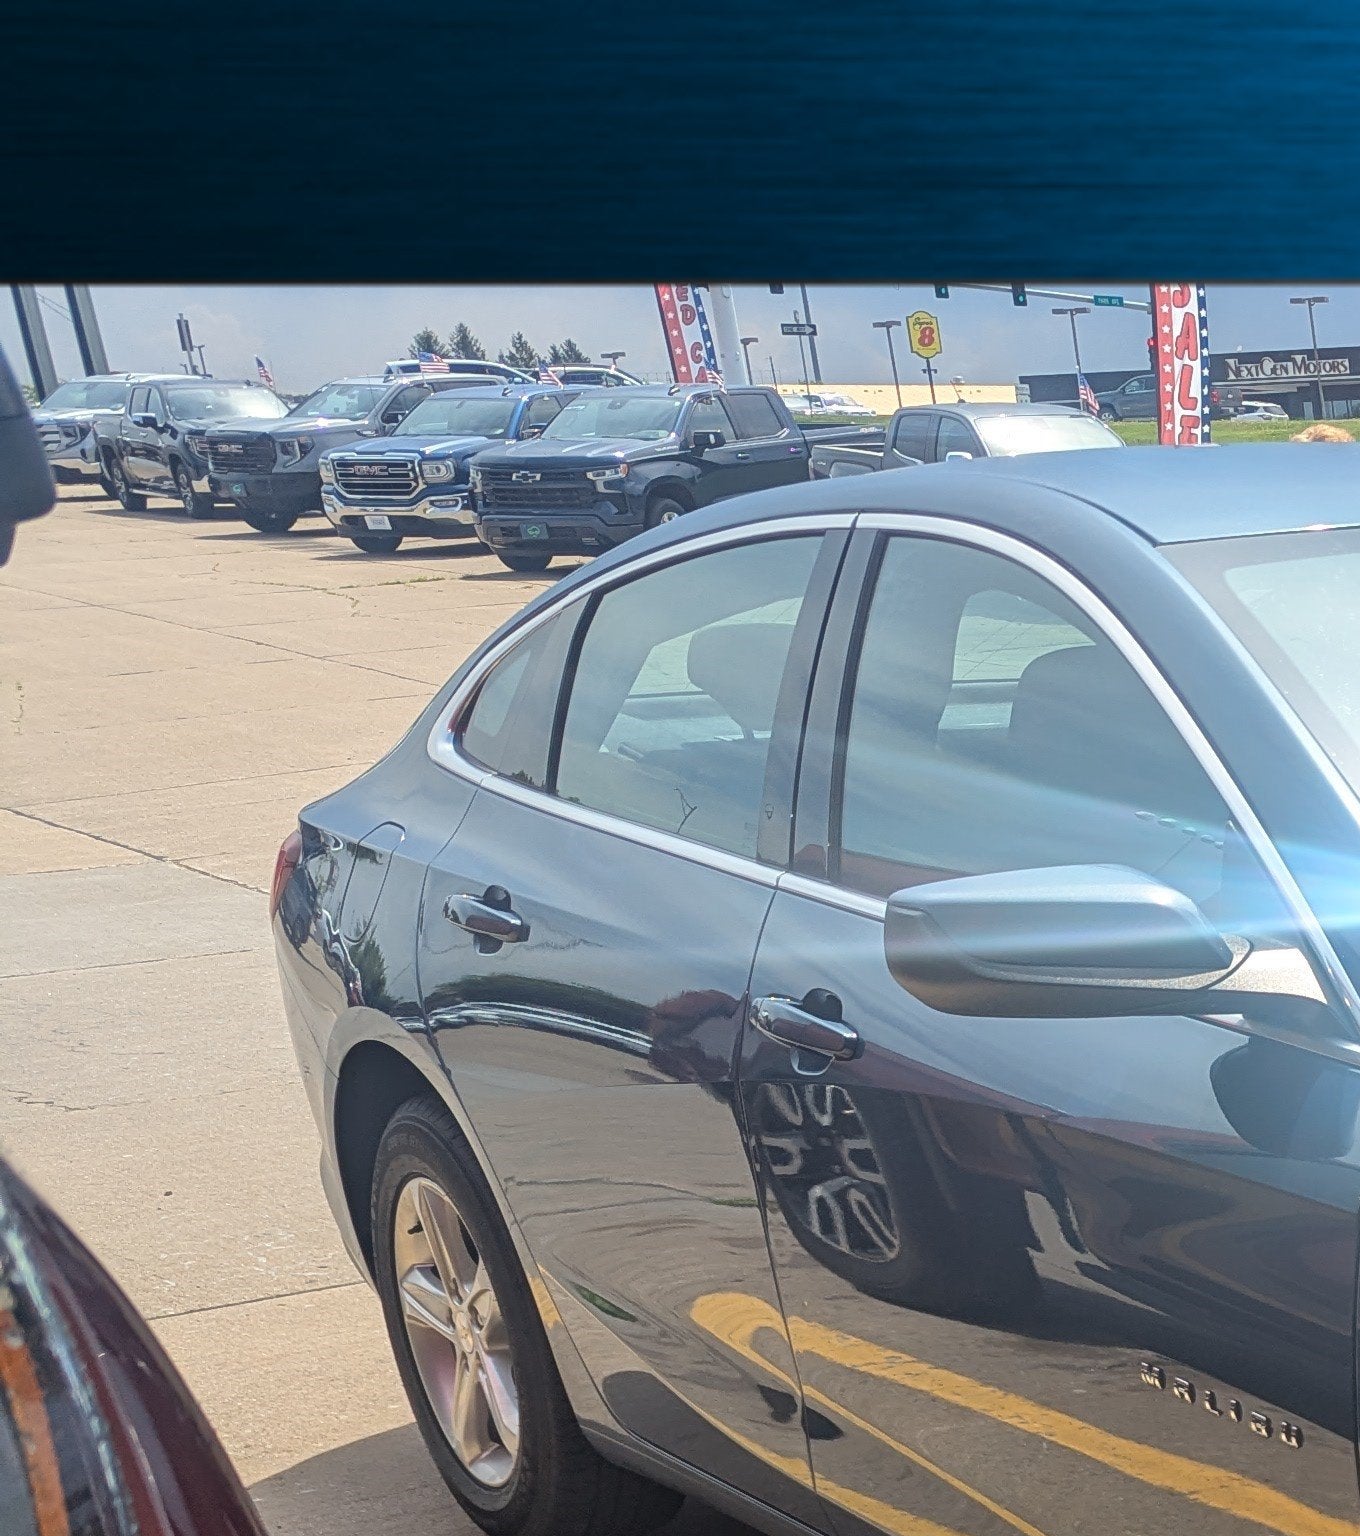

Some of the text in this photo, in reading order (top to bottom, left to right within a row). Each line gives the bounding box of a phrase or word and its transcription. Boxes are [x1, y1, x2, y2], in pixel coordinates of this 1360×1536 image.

[918, 327, 935, 347] 8
[353, 465, 389, 476] GMC
[1140, 1361, 1304, 1449] MALIBU
